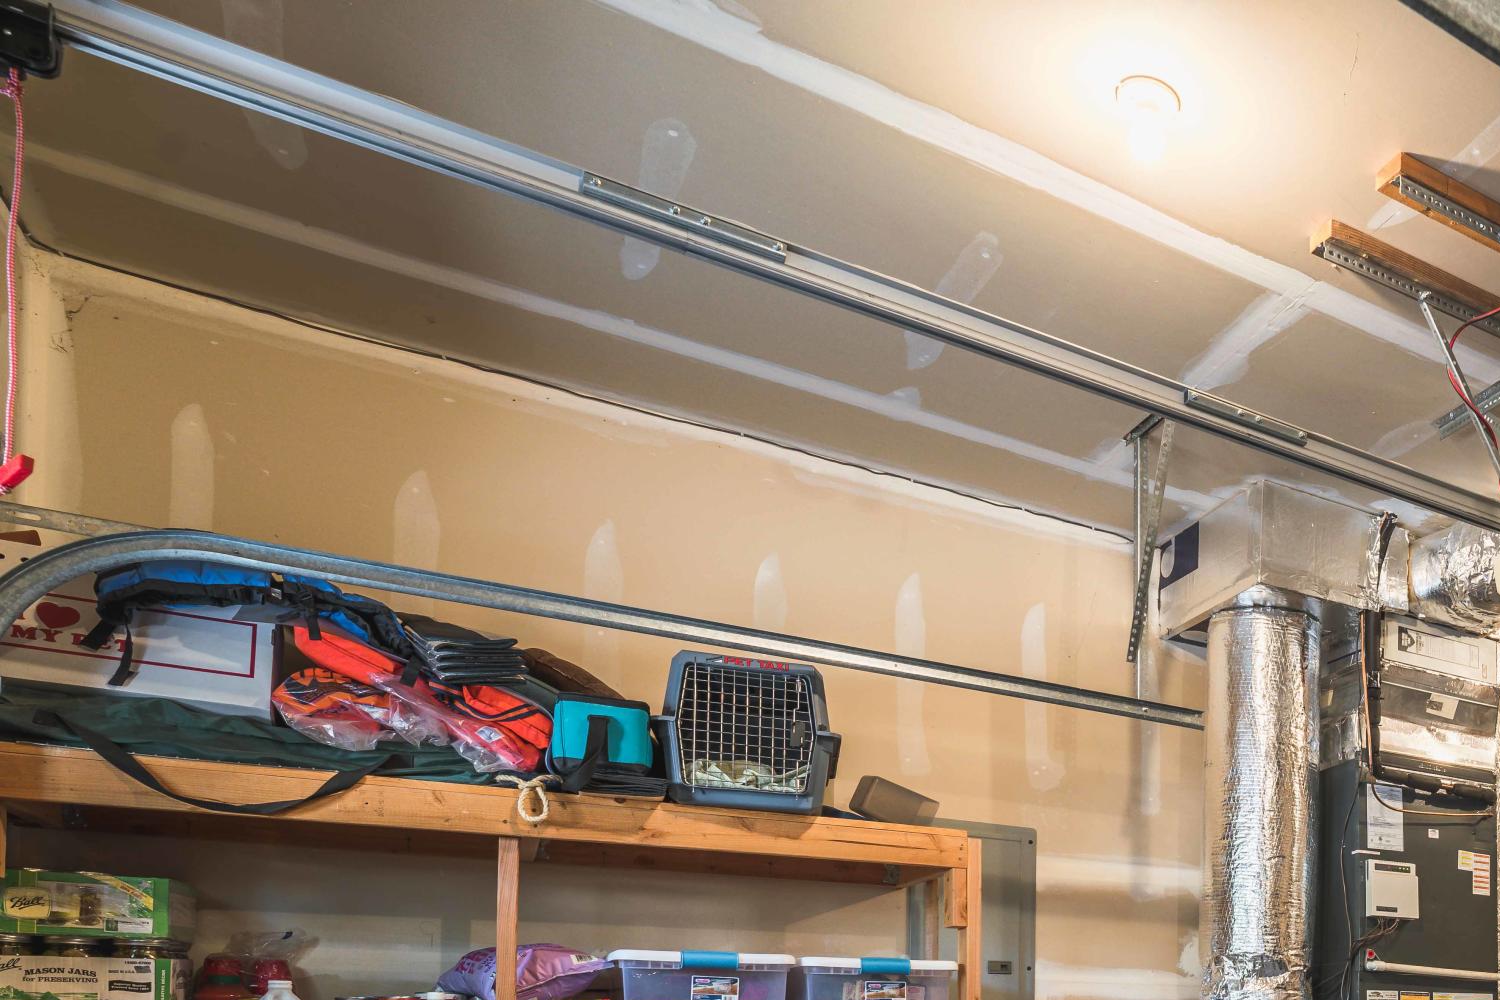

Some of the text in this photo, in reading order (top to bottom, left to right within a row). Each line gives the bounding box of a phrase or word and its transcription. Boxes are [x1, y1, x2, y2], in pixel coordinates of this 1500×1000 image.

[10, 624, 127, 653] MY PT
[10, 896, 45, 910] Ball
[0, 957, 22, 971] all
[25, 967, 97, 977] MASON JARS
